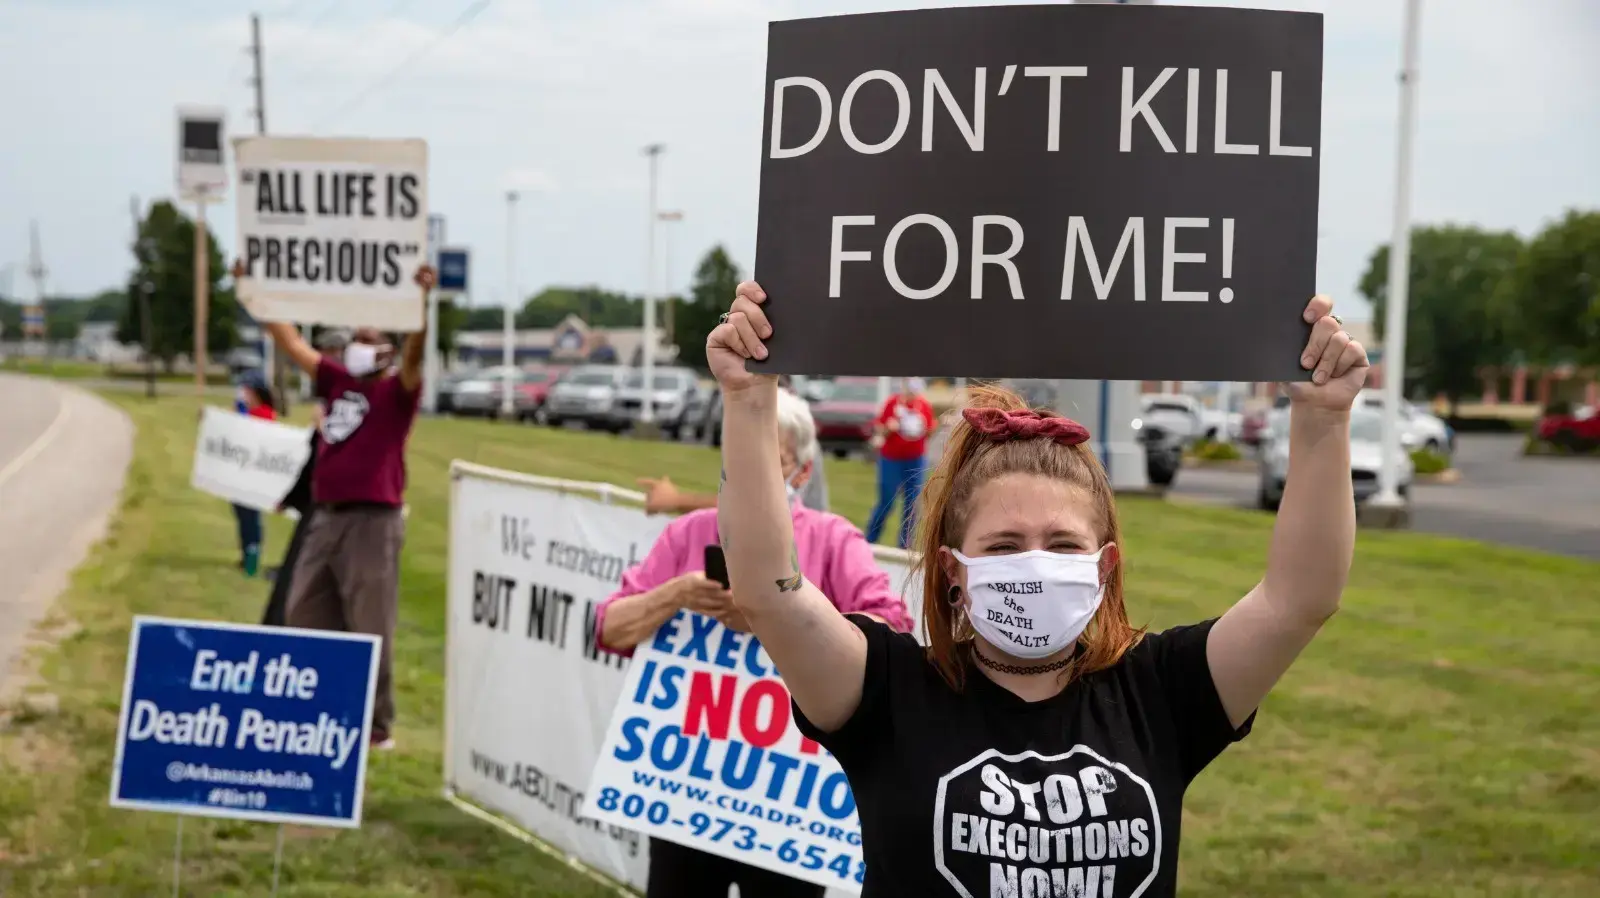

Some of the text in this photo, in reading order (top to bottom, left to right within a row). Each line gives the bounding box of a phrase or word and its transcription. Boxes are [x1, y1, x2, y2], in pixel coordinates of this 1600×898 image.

[770, 65, 1313, 159] DON'T KILL
[316, 171, 376, 217] LIFE
[387, 173, 420, 219] IS
[829, 213, 1236, 304] FOR ME!
[501, 513, 535, 561] We
[473, 570, 517, 632] BUT
[527, 584, 575, 649] NOT
[987, 608, 1033, 630] DEATH
[1003, 595, 1025, 614] the
[652, 607, 781, 677] EXEC
[190, 650, 318, 700] End the
[129, 700, 360, 770] Death Penalty
[633, 660, 820, 756] IS NO
[165, 760, 314, 791] @ArkansasAbolish
[613, 717, 864, 827] SOLUTIO
[980, 764, 1117, 824] STOP
[952, 812, 1149, 863] EXECUTIONS
[990, 863, 1116, 898] NOW!
